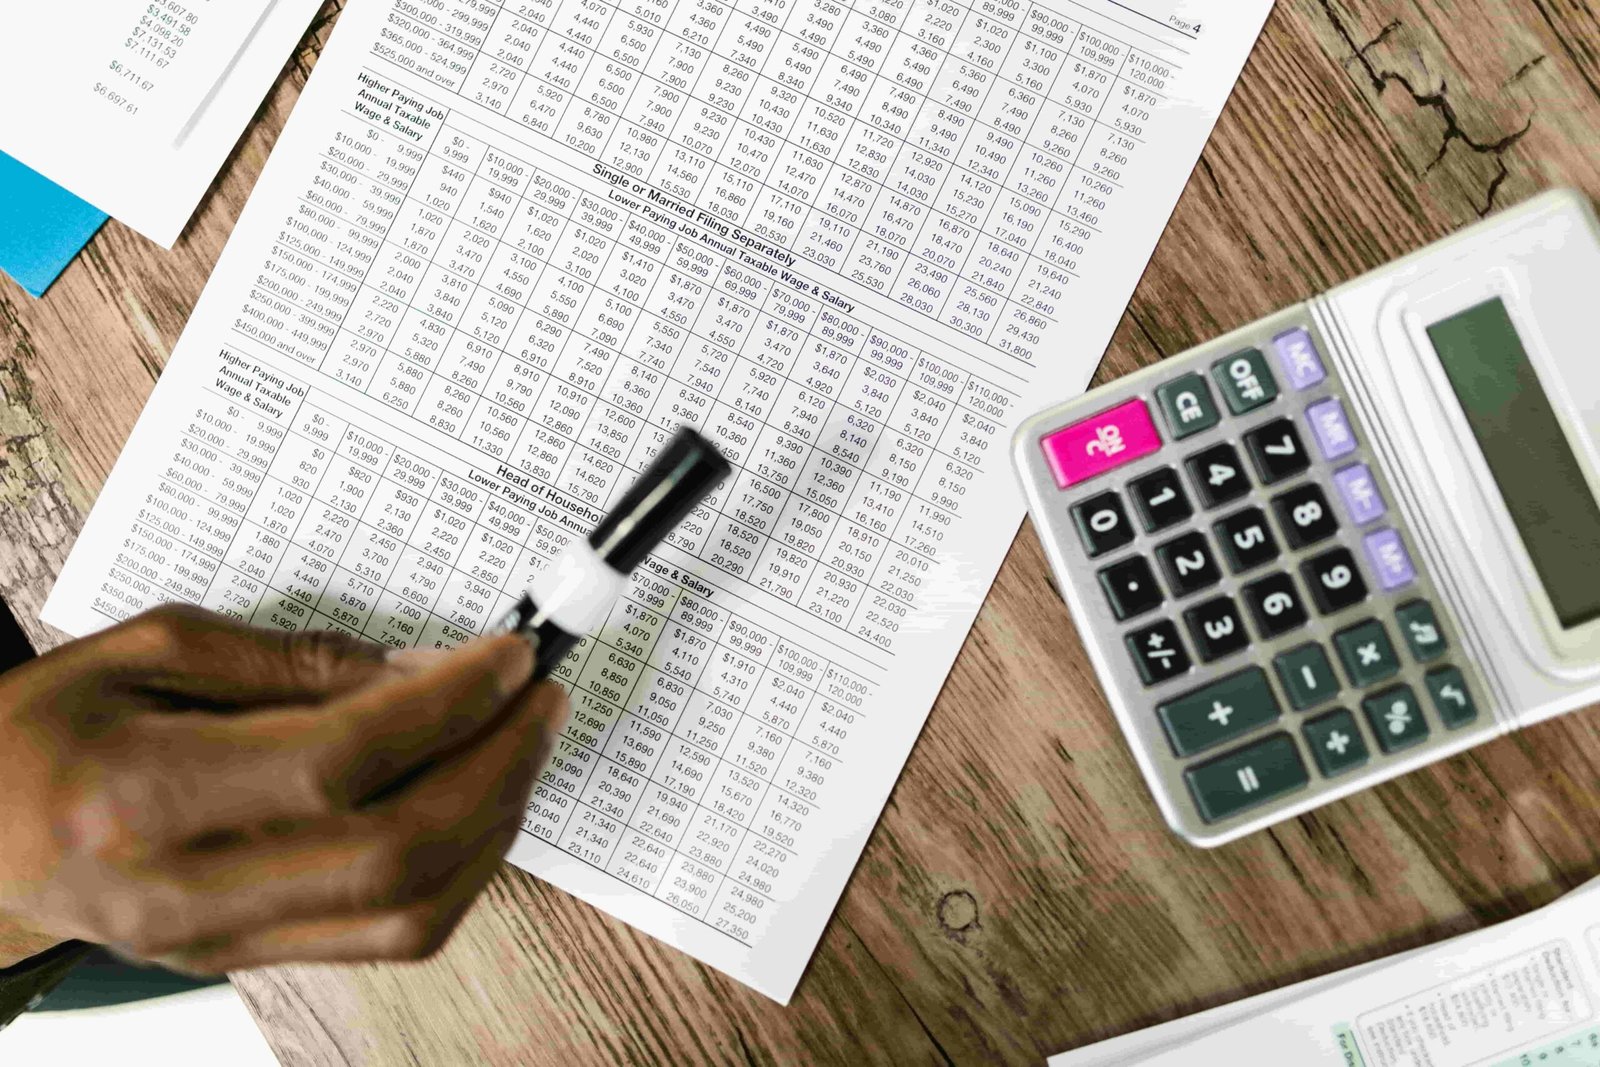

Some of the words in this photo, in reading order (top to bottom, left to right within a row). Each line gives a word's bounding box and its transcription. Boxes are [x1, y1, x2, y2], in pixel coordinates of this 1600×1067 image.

[1168, 14, 1191, 30] Page
[1192, 23, 1201, 34] 4
[975, 18, 1008, 39] $1,020
[1024, 40, 1057, 61] $1,100
[1073, 62, 1107, 83] $1,870
[1122, 85, 1156, 106] $1,870
[356, 71, 390, 93] Higher
[390, 88, 424, 111] Paying
[425, 106, 444, 120] Job
[357, 88, 393, 110] Annual
[394, 104, 430, 129] Taxable
[634, 5, 661, 23] 5,010
[681, 27, 708, 45] 6,210
[730, 48, 756, 67] 7,340
[777, 71, 804, 89] 8,340
[825, 93, 853, 111] 9,340
[870, 113, 901, 134] 10,340
[919, 136, 950, 156] 11,340
[967, 158, 999, 179] 12,340
[1017, 181, 1048, 202] 13,260
[1066, 204, 1098, 225] 13,460
[354, 100, 381, 121] Wage
[392, 120, 423, 141] Salary
[373, 42, 415, 68] $525,000
[415, 64, 434, 77] and
[434, 74, 455, 85] over
[475, 91, 501, 109] 3,140
[522, 113, 548, 131] 6,840
[565, 133, 595, 154] 10,200
[612, 155, 643, 176] 12,900
[660, 178, 690, 198] 15,530
[708, 200, 739, 221] 18,030
[753, 223, 787, 244] 20,530
[802, 245, 835, 267] 23,030
[850, 269, 884, 290] 25,530
[899, 292, 933, 313] 28,030
[949, 315, 982, 336] 30,300
[998, 338, 1032, 359] 31,800
[592, 163, 629, 187] Single
[631, 184, 646, 194] or
[646, 188, 695, 218] Married
[695, 211, 729, 236] Filing
[731, 228, 796, 267] Separately
[607, 188, 641, 210] Lower
[641, 204, 677, 229] Paying
[677, 223, 698, 238] Job
[698, 233, 737, 256] Annual
[738, 249, 777, 276] Taxable
[780, 269, 809, 291] Wage
[821, 290, 855, 313] Salary
[366, 128, 379, 140] $0
[396, 144, 423, 161] 9,999
[441, 165, 465, 181] $440
[487, 187, 512, 204] $940
[526, 205, 559, 227] $1,020
[574, 228, 606, 249] $1,020
[621, 250, 654, 272] $1,410
[669, 273, 702, 295] $1,870
[717, 296, 750, 318] $1,870
[765, 319, 799, 341] $1,870
[814, 342, 847, 364] $1,870
[863, 366, 896, 388] $2,030
[912, 389, 946, 411] $2,040
[961, 413, 995, 435] $2,040
[305, 189, 342, 213] $60,000
[355, 214, 386, 234] 79,999
[403, 237, 428, 254] 1,870
[448, 259, 475, 277] 3,470
[495, 282, 522, 300] 4,690
[542, 304, 569, 323] 5,890
[590, 327, 617, 346] 7,090
[638, 350, 665, 369] 7,740
[686, 373, 713, 392] 7,940
[734, 397, 762, 415] 8,140
[783, 420, 810, 439] 8,340
[831, 444, 859, 463] 8,540
[881, 467, 909, 487] 9,190
[930, 491, 958, 510] 9,990
[218, 348, 251, 370] Higher
[251, 365, 284, 389] Paying
[285, 383, 304, 397] Job
[218, 365, 253, 387] Annual
[254, 381, 291, 406] Taxable
[1230, 358, 1264, 400] OFF
[215, 377, 242, 397] Wage
[252, 396, 283, 418] Salary
[1176, 391, 1202, 424] CE
[1265, 435, 1296, 456] 7
[495, 464, 530, 488] Head
[530, 483, 545, 495] of
[545, 488, 604, 525] Househol
[1209, 463, 1236, 486] 4
[1149, 487, 1176, 506] 1
[1293, 501, 1322, 527] 8
[467, 468, 501, 491] Lower
[501, 485, 537, 511] Paying
[537, 504, 558, 520] Job
[561, 515, 593, 537] Annua
[680, 574, 714, 598] Salary
[1090, 509, 1118, 532] 0
[1233, 527, 1265, 549] 5
[1175, 550, 1205, 576] 2
[1321, 565, 1351, 589] 9
[1263, 592, 1293, 616] 6
[165, 467, 202, 490] $60,000
[215, 491, 246, 512] 79,999
[262, 516, 287, 534] 1,870
[308, 539, 334, 557] 4,070
[354, 562, 381, 581] 5,310
[401, 586, 428, 605] 6,600
[449, 609, 476, 629] 7,800
[589, 680, 620, 701] 10,850
[637, 704, 669, 726] 11,050
[686, 729, 718, 750] 11,250
[735, 754, 767, 775] 11,520
[785, 779, 816, 800] 12,320
[1204, 615, 1234, 640] 3
[1147, 632, 1176, 669] +/-
[1208, 701, 1233, 726] +
[1384, 700, 1412, 735] %
[1237, 766, 1260, 792] =
[542, 770, 575, 792] 20,040
[590, 795, 624, 817] 21,340
[639, 820, 672, 842] 22,640
[688, 845, 722, 867] 23,880
[737, 870, 771, 893] 24,980
